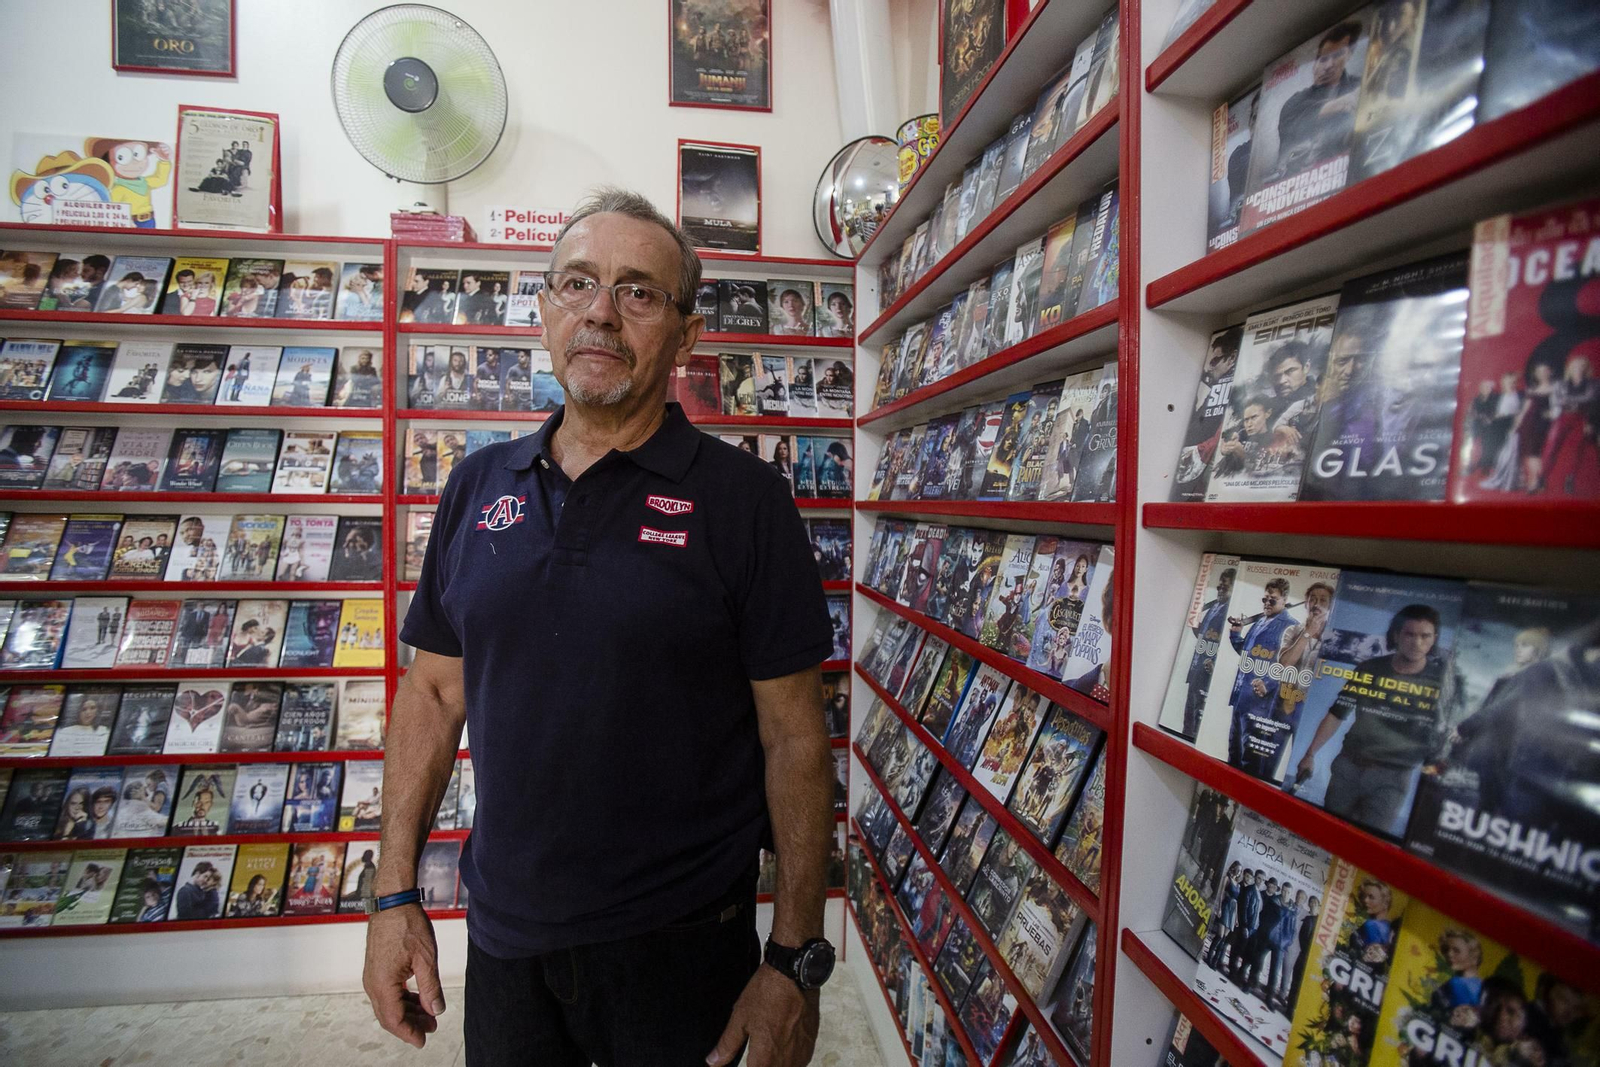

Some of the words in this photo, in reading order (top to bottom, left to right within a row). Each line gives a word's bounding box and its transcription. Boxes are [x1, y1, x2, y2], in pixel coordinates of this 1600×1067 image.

[154, 39, 194, 53] ORO
[704, 218, 733, 227] MULA
[1088, 190, 1113, 261] PREDATOR
[1316, 306, 1331, 314] TORO
[736, 319, 762, 327] GREY
[287, 356, 328, 364] MODISTA
[122, 441, 160, 449] VIAJE
[227, 441, 250, 449] GREEN
[1332, 437, 1366, 445] McAVOY
[650, 498, 690, 511] BROOKLYN
[489, 497, 514, 527] A
[238, 521, 277, 529] wonder
[1247, 566, 1273, 575] RUSSELL
[1274, 567, 1301, 577] CROWE
[1309, 571, 1329, 579] RYAN
[1080, 630, 1102, 648] MARY
[1069, 636, 1101, 665] POPPINS
[1322, 665, 1374, 684] DOBLE
[1342, 684, 1386, 700] JAQUE
[1392, 695, 1411, 706] AL
[304, 710, 326, 718] AÑOS
[294, 717, 326, 725] PERDÓN
[1238, 834, 1284, 866] AHORA
[1291, 858, 1314, 879] ME
[1175, 874, 1211, 924] AHORA
[1017, 912, 1051, 956] PRUEBAS
